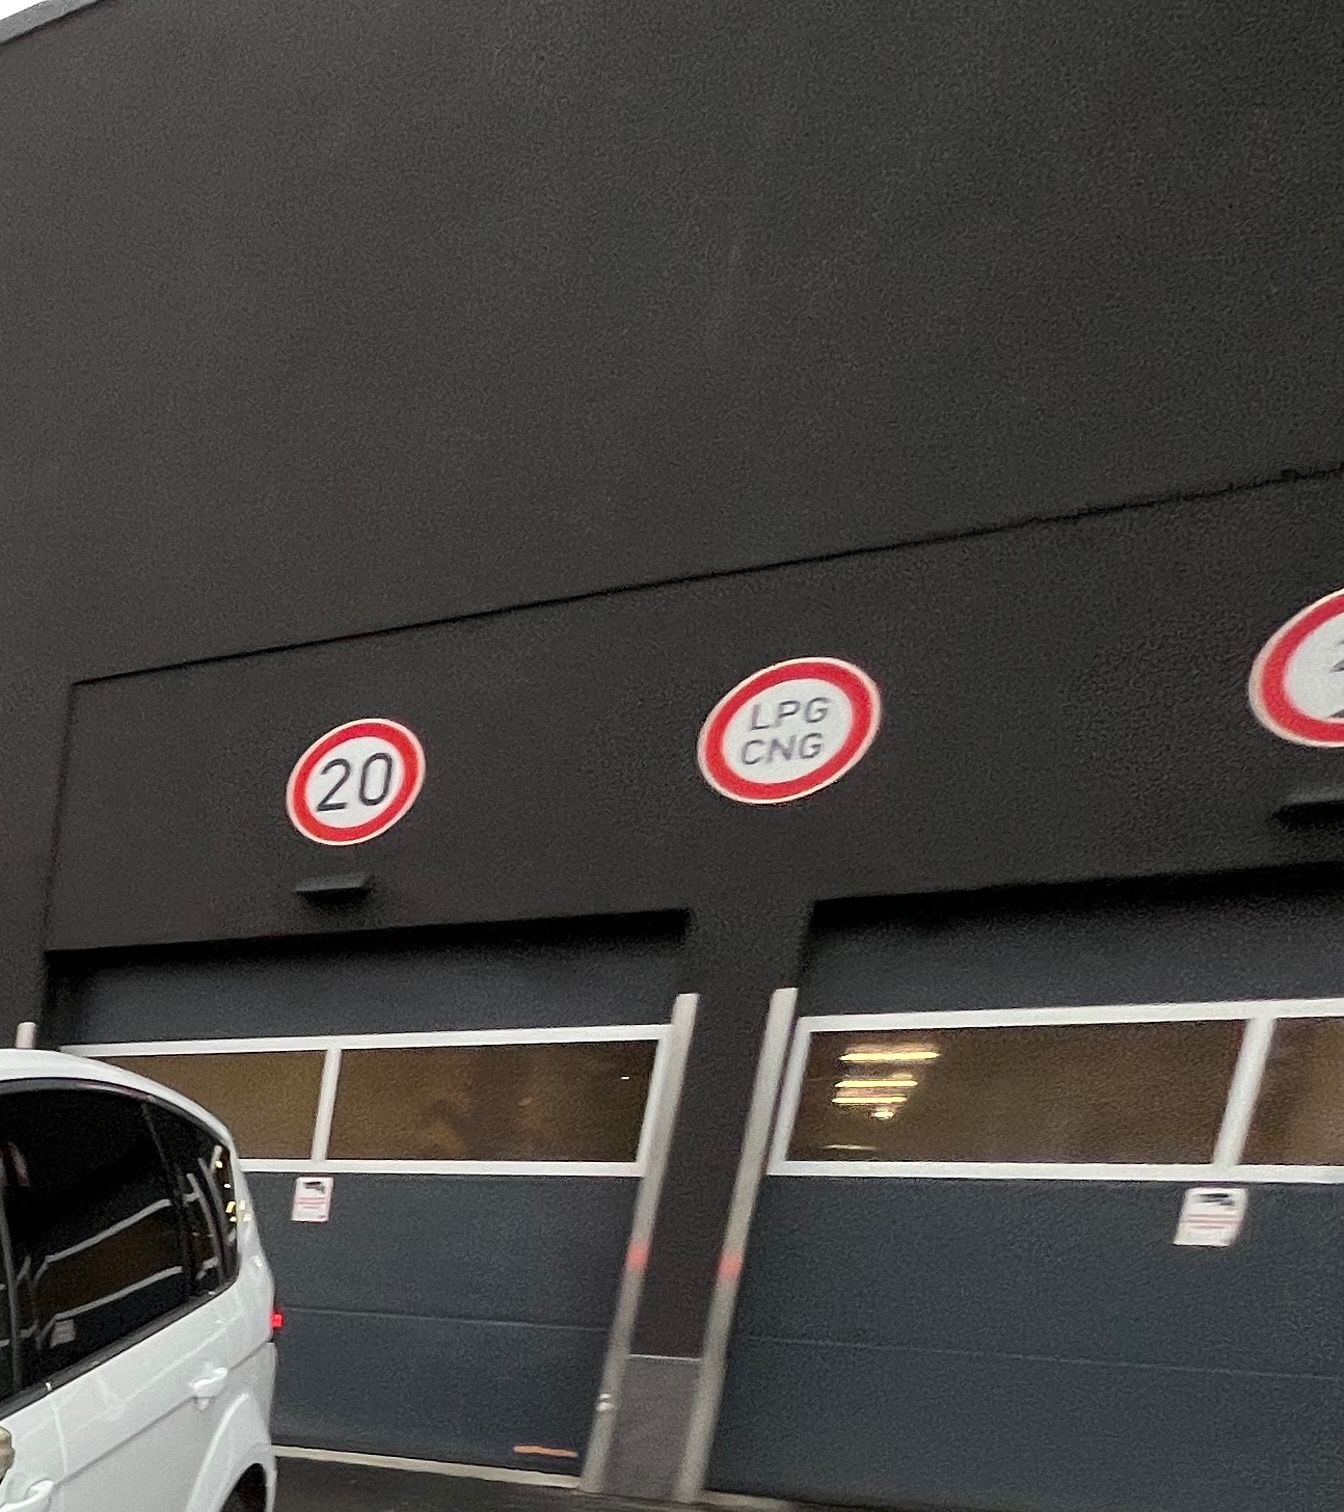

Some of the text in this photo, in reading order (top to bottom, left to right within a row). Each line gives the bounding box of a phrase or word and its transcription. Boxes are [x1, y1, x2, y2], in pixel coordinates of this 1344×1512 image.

[749, 697, 831, 731] LPG
[740, 732, 824, 765] CNG
[316, 752, 393, 812] 20
